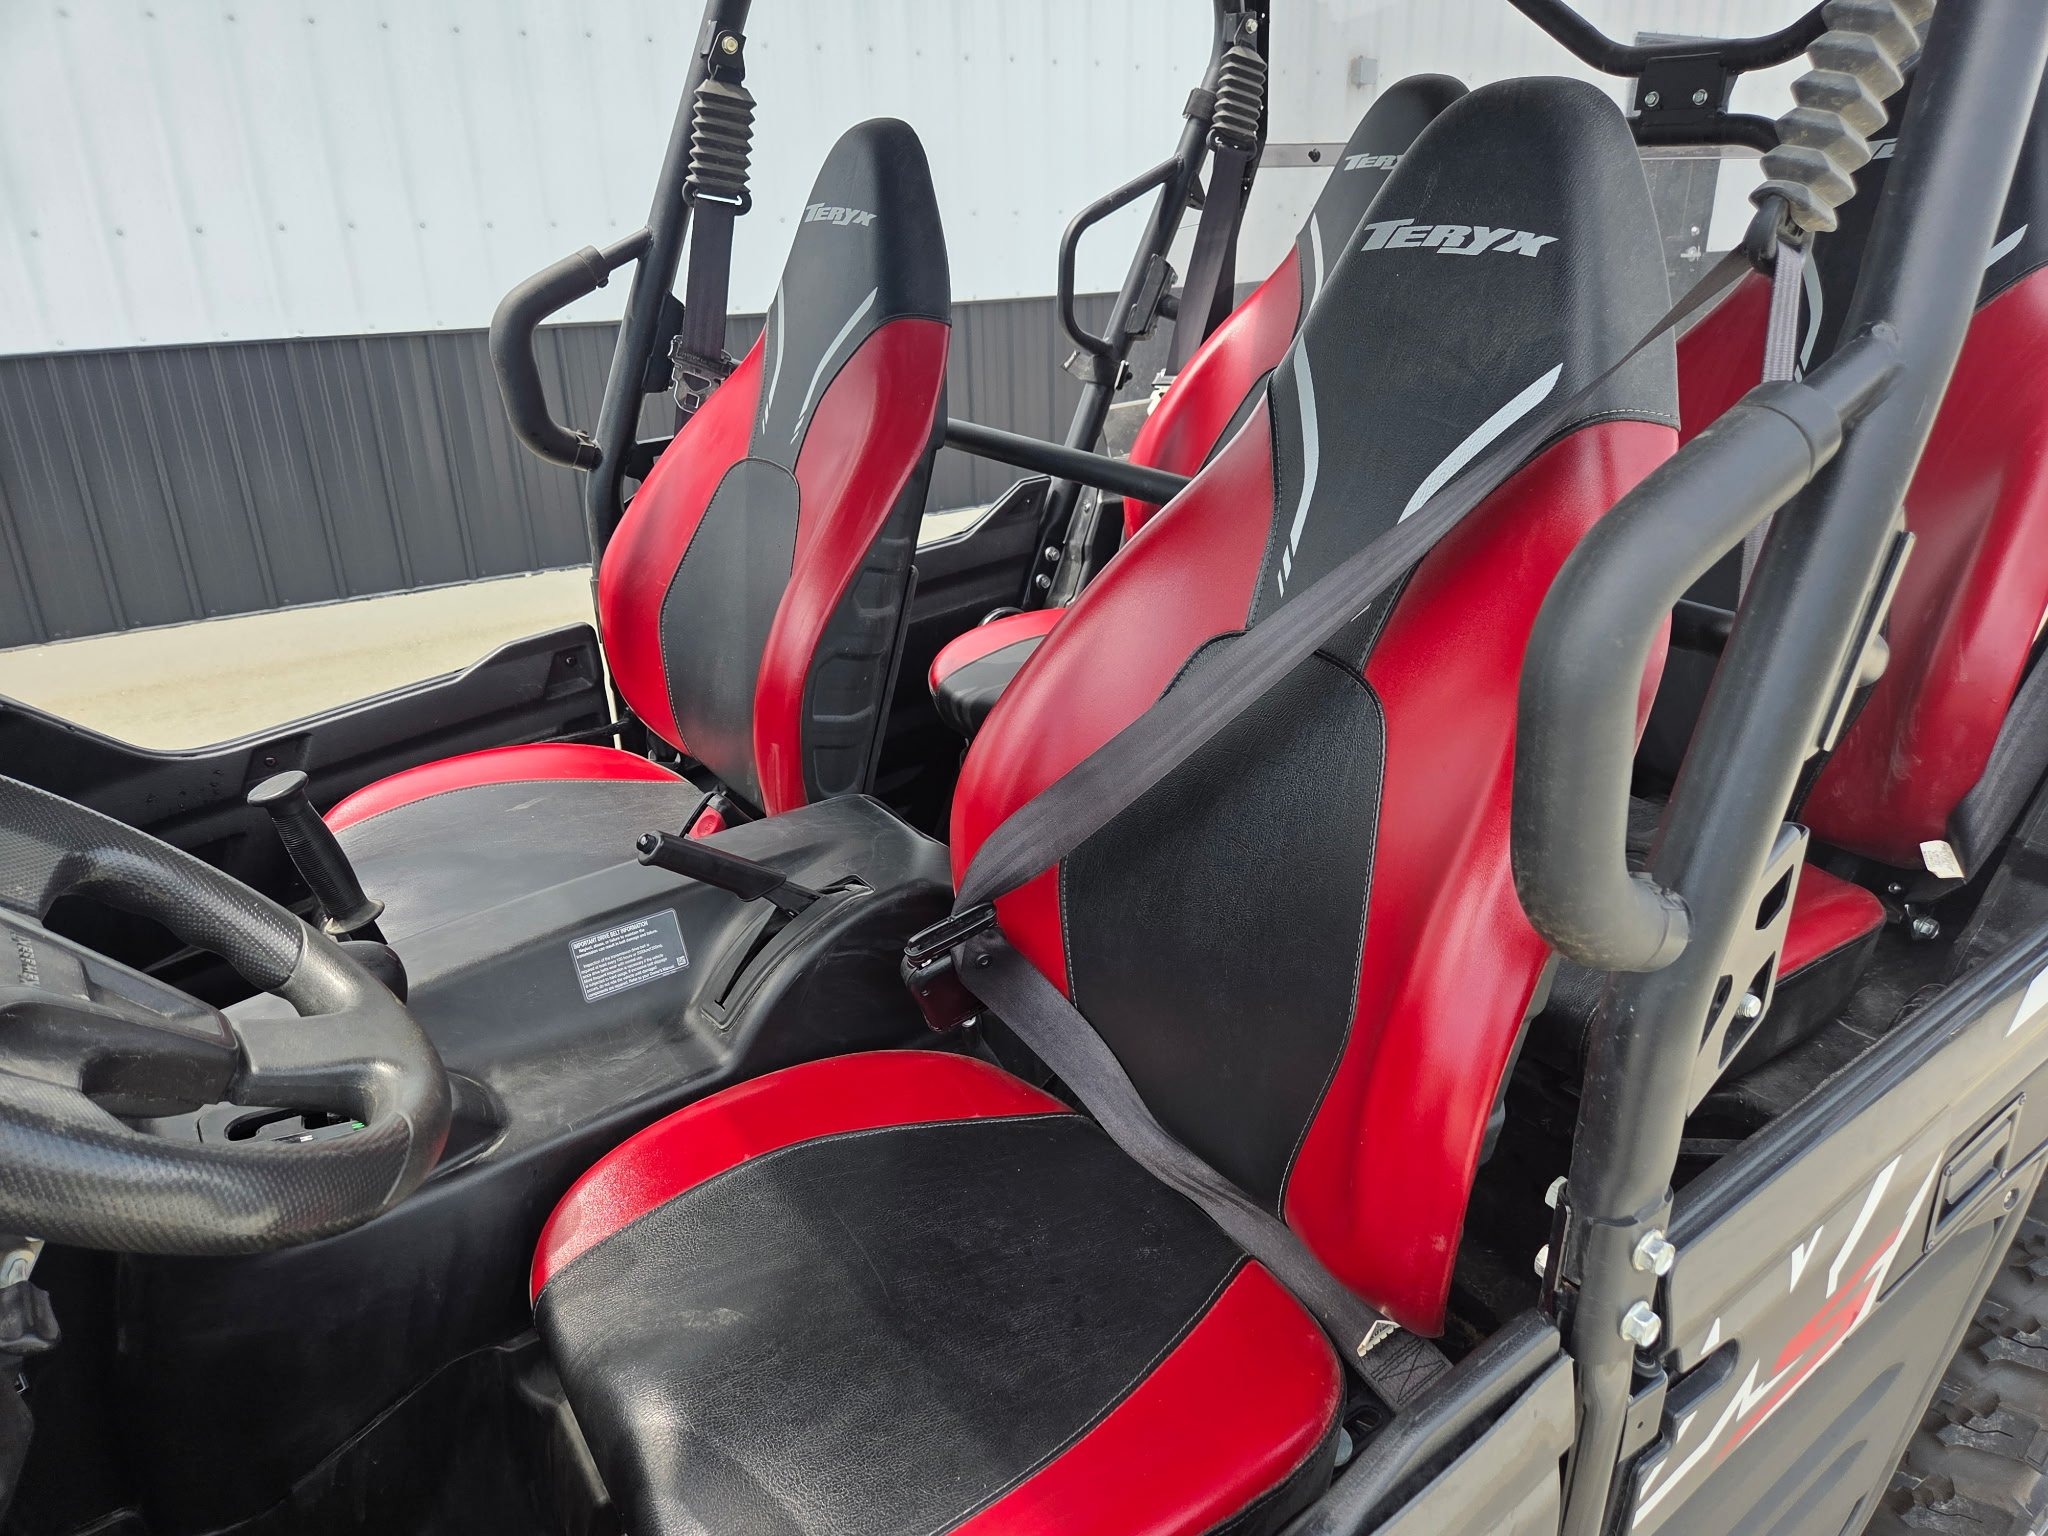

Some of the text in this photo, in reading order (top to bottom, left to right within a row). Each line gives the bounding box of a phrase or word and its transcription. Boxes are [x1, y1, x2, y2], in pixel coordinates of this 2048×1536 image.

[1344, 153, 1404, 171] TER
[804, 202, 878, 227] TERYX
[1361, 218, 1559, 258] TERYX
[573, 937, 597, 949] IMPORTANT
[597, 933, 610, 941] DRIVE
[620, 921, 648, 934] INFORMATION
